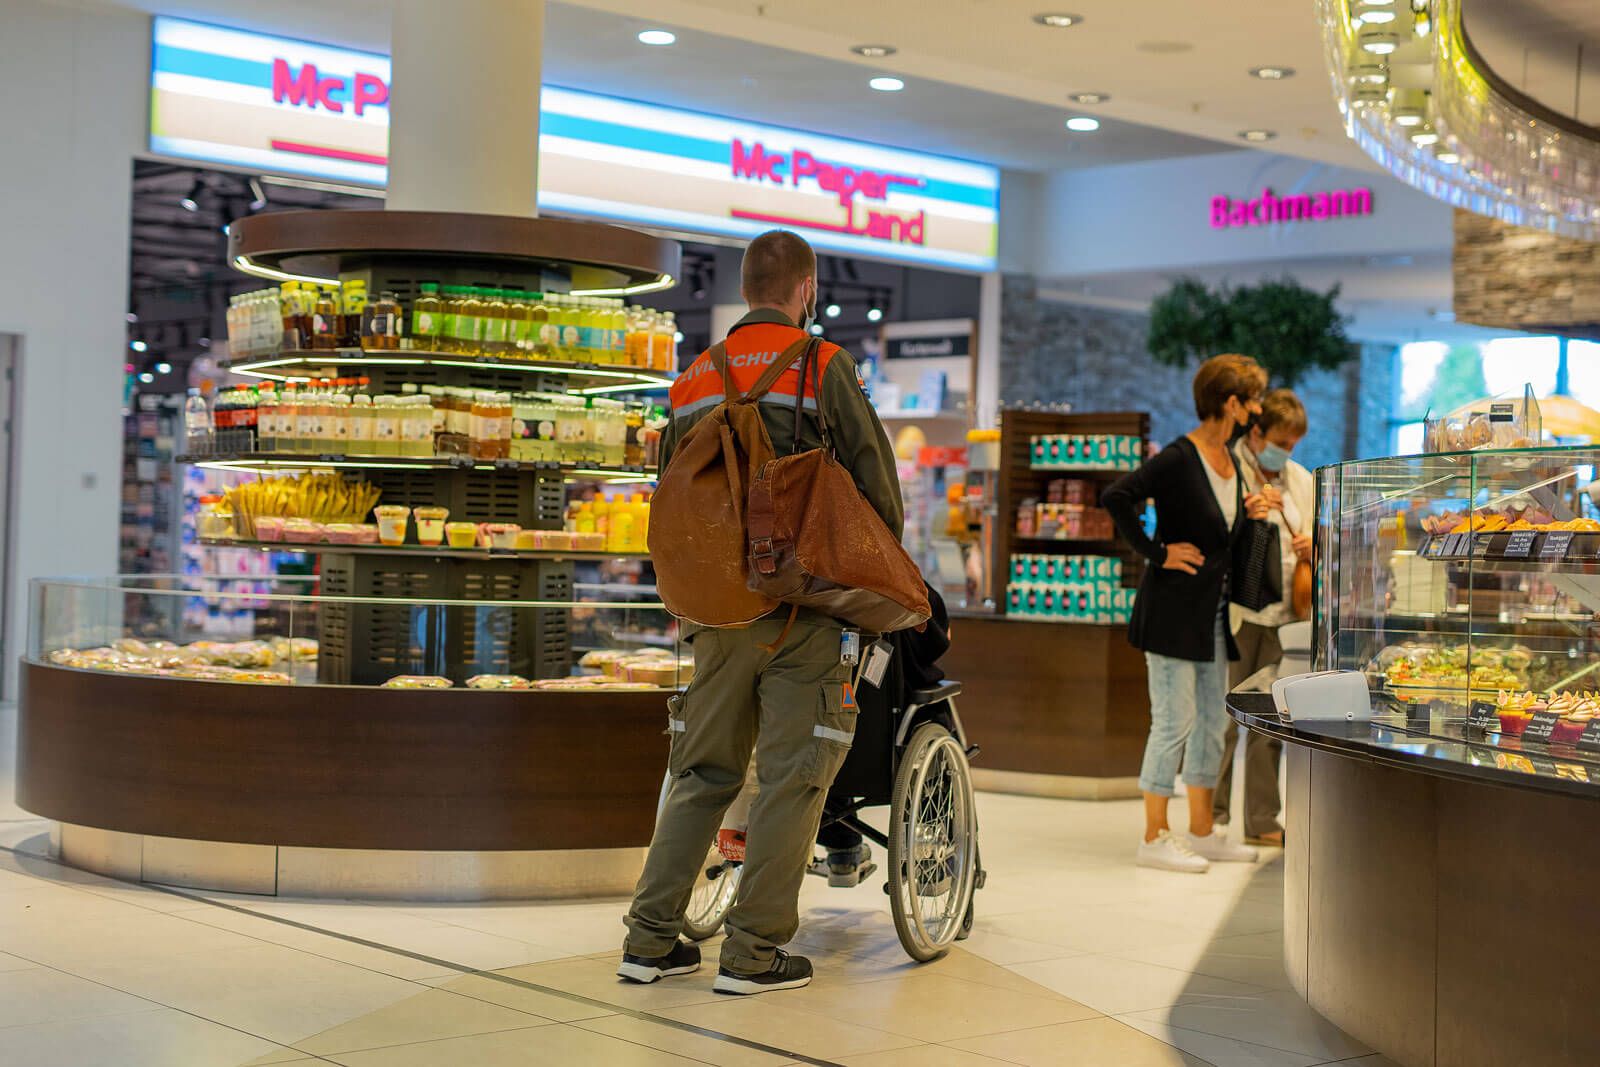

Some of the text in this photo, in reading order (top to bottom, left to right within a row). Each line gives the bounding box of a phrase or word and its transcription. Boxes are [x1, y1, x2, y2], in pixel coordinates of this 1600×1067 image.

[273, 57, 390, 116] Mc P
[732, 138, 924, 207] Mc Paper
[845, 203, 925, 245] Land
[1210, 187, 1373, 230] Bachmann
